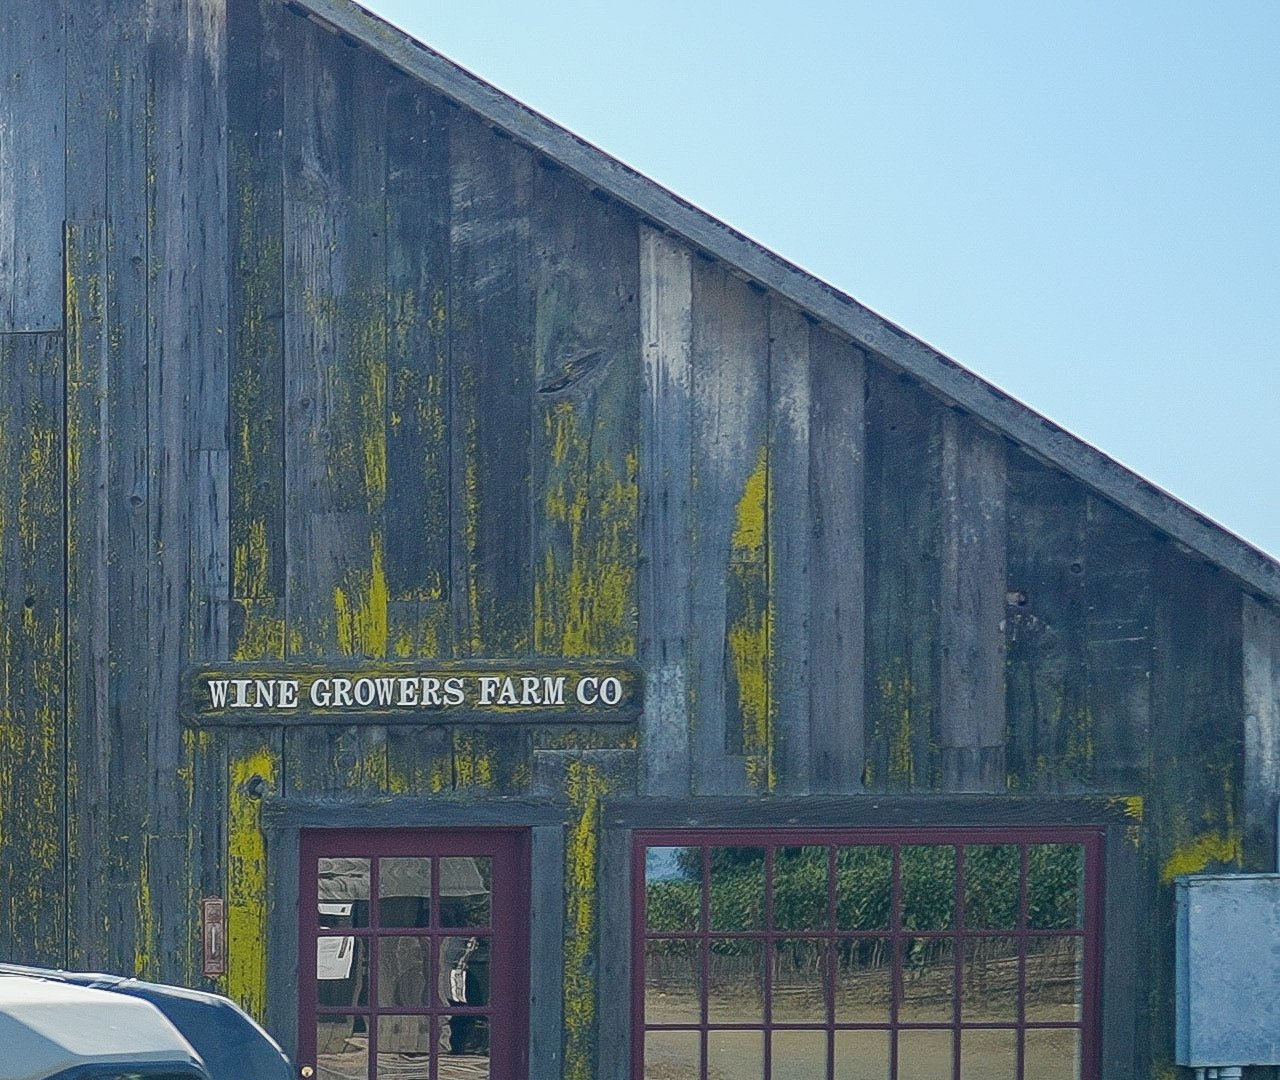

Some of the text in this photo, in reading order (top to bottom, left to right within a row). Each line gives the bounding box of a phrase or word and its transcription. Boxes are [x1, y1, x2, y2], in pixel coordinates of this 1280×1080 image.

[207, 676, 623, 708] WINE GROWERS FARM CO
